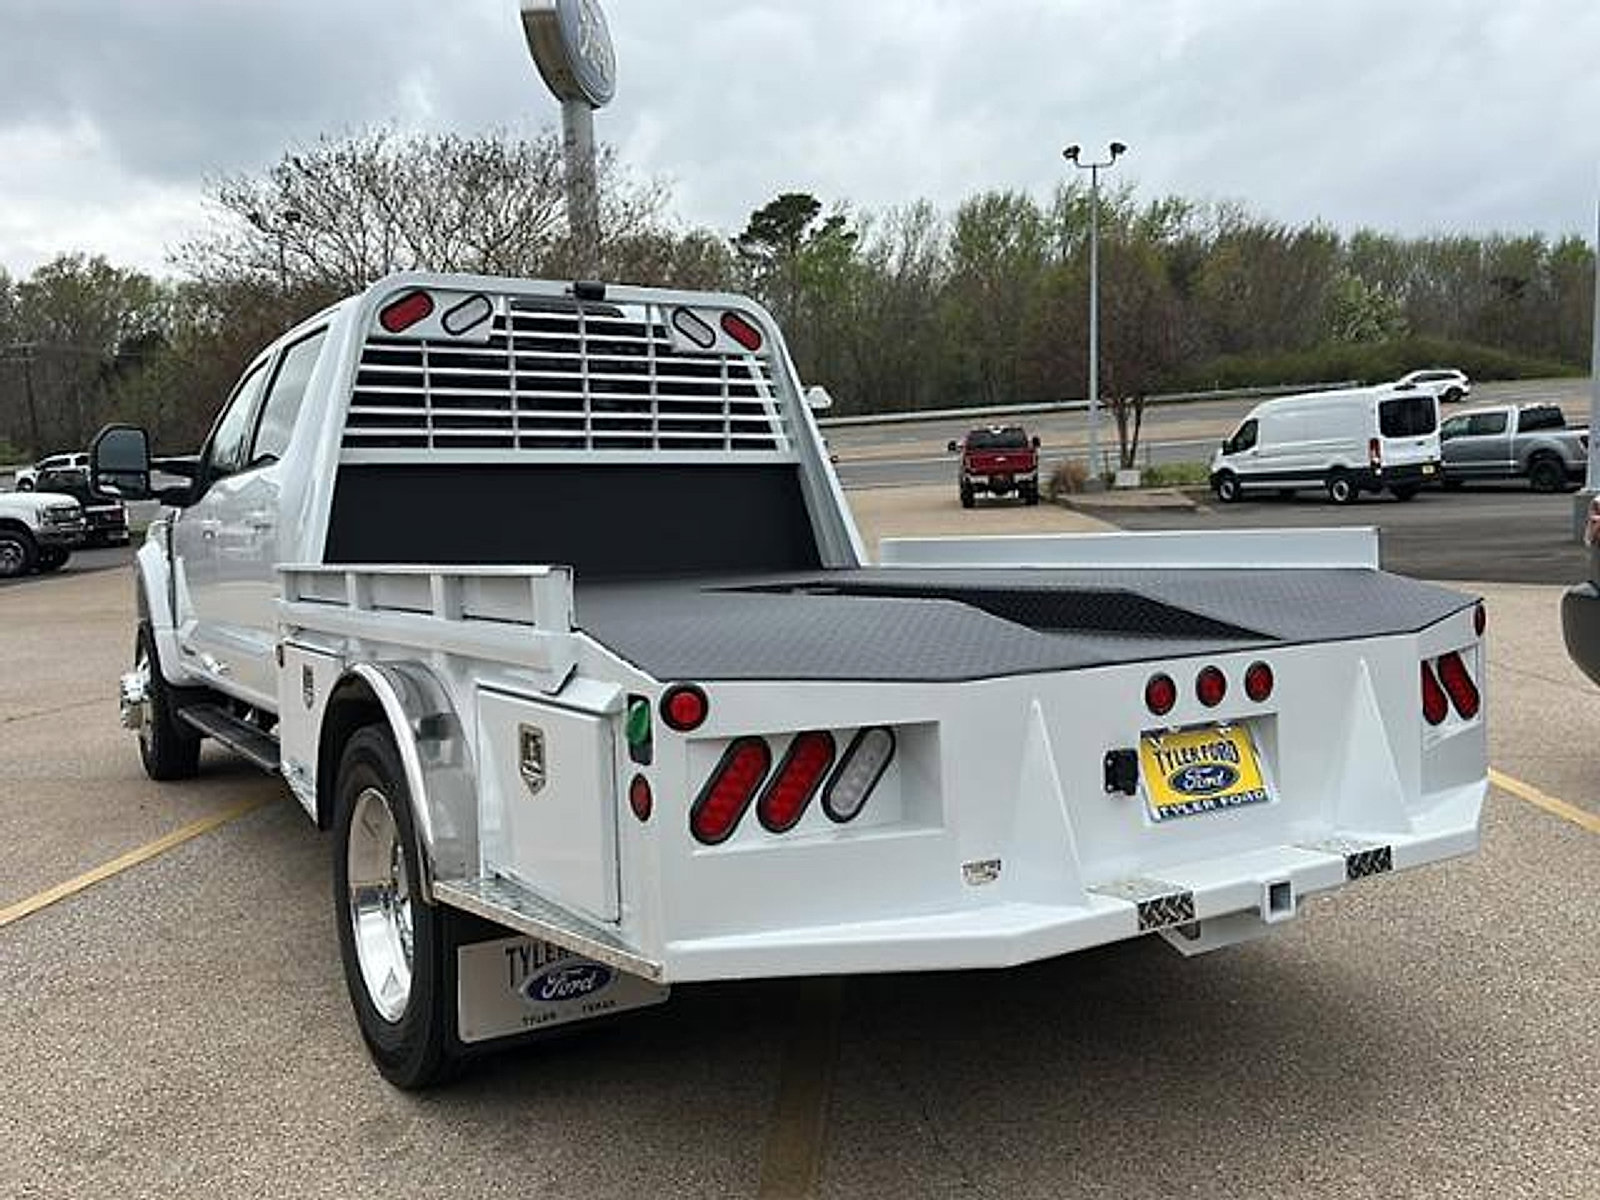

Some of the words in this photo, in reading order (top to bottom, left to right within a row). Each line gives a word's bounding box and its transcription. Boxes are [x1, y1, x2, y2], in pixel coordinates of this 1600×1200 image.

[1183, 767, 1225, 791] Ford
[1160, 801, 1216, 817] TYLER
[541, 967, 597, 999] Ford
